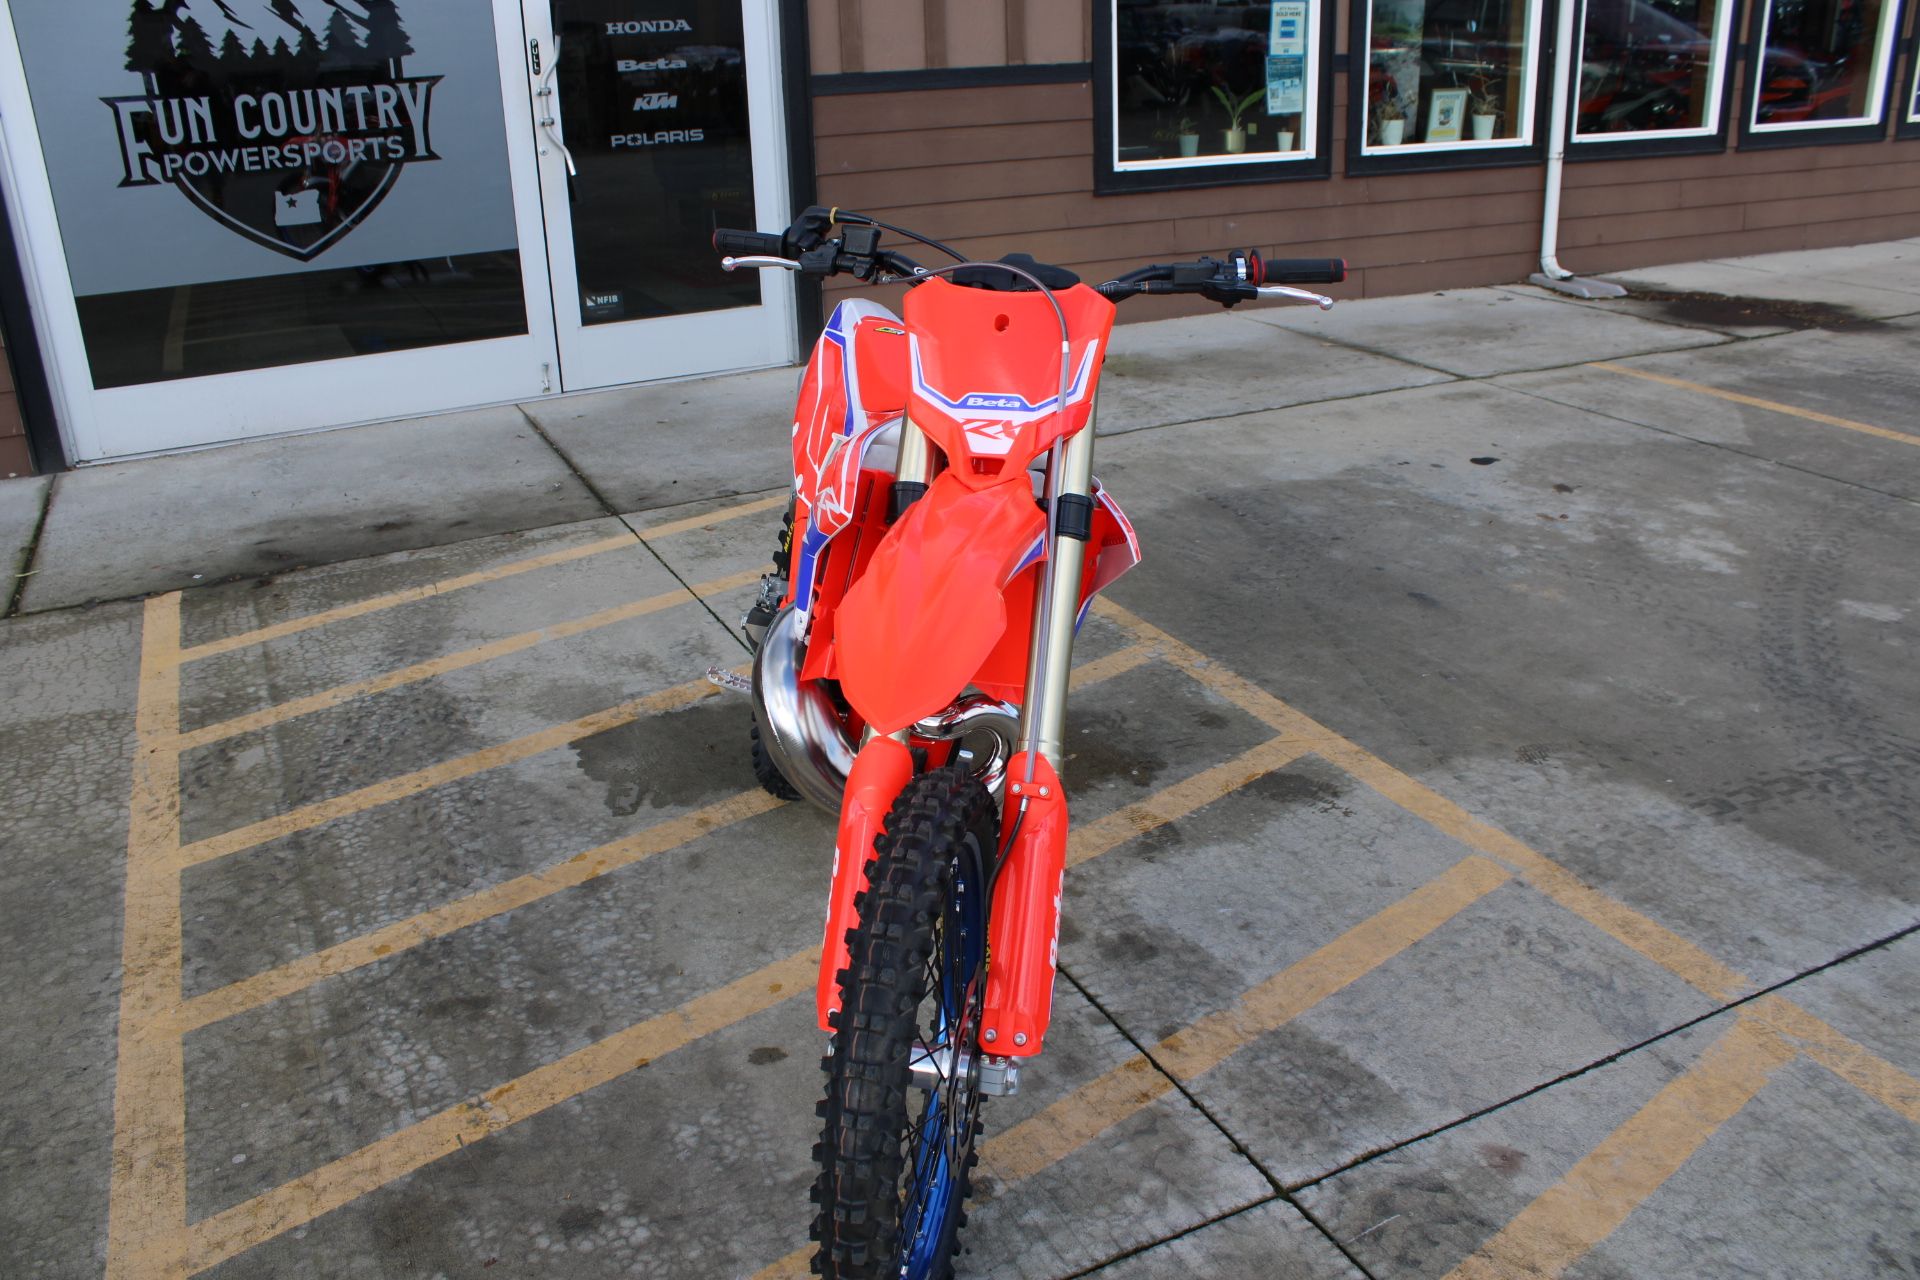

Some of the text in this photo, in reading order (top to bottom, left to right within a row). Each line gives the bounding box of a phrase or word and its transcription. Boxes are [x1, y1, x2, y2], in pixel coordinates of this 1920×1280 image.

[606, 19, 692, 35] HONDA
[531, 40, 539, 70] PULL
[617, 58, 687, 72] Beta
[633, 92, 678, 111] KTM
[115, 82, 430, 182] FUN COUNTRY
[611, 129, 704, 147] POLARIS
[165, 136, 405, 178] POWERSPORTS
[967, 397, 1021, 408] Beta
